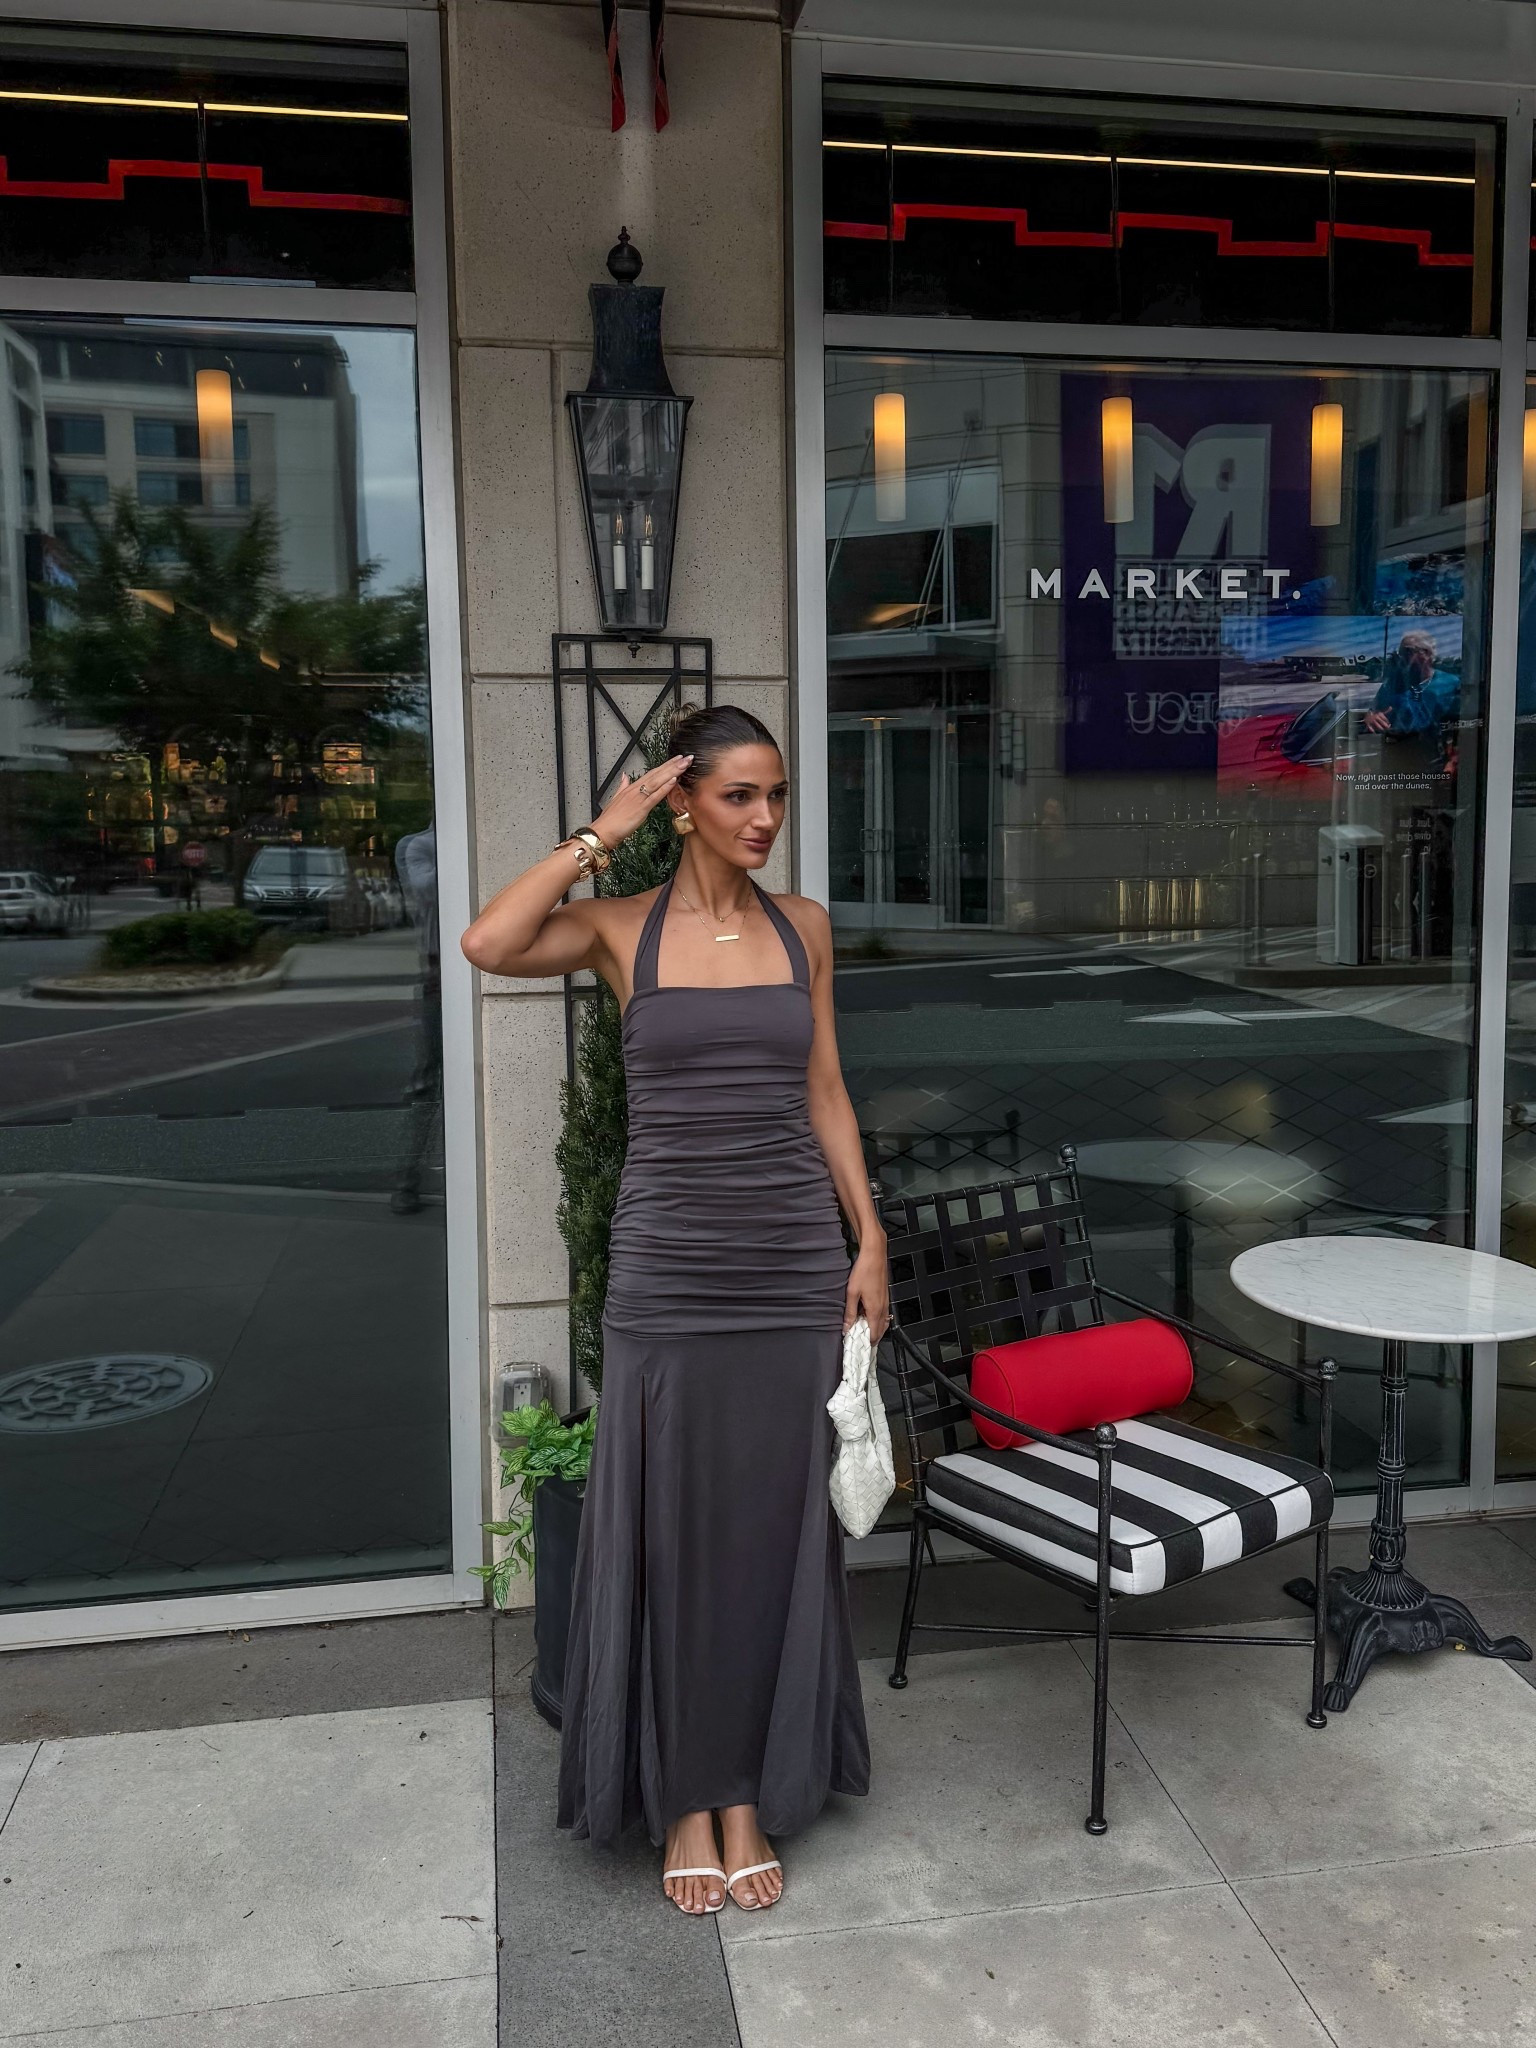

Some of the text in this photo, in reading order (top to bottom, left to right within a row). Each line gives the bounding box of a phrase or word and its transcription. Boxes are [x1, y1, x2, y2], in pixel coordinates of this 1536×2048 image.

[1030, 568, 1301, 600] MARKET.
[1335, 774, 1357, 782] Now,
[1357, 773, 1376, 782] right
[1378, 774, 1396, 782] past
